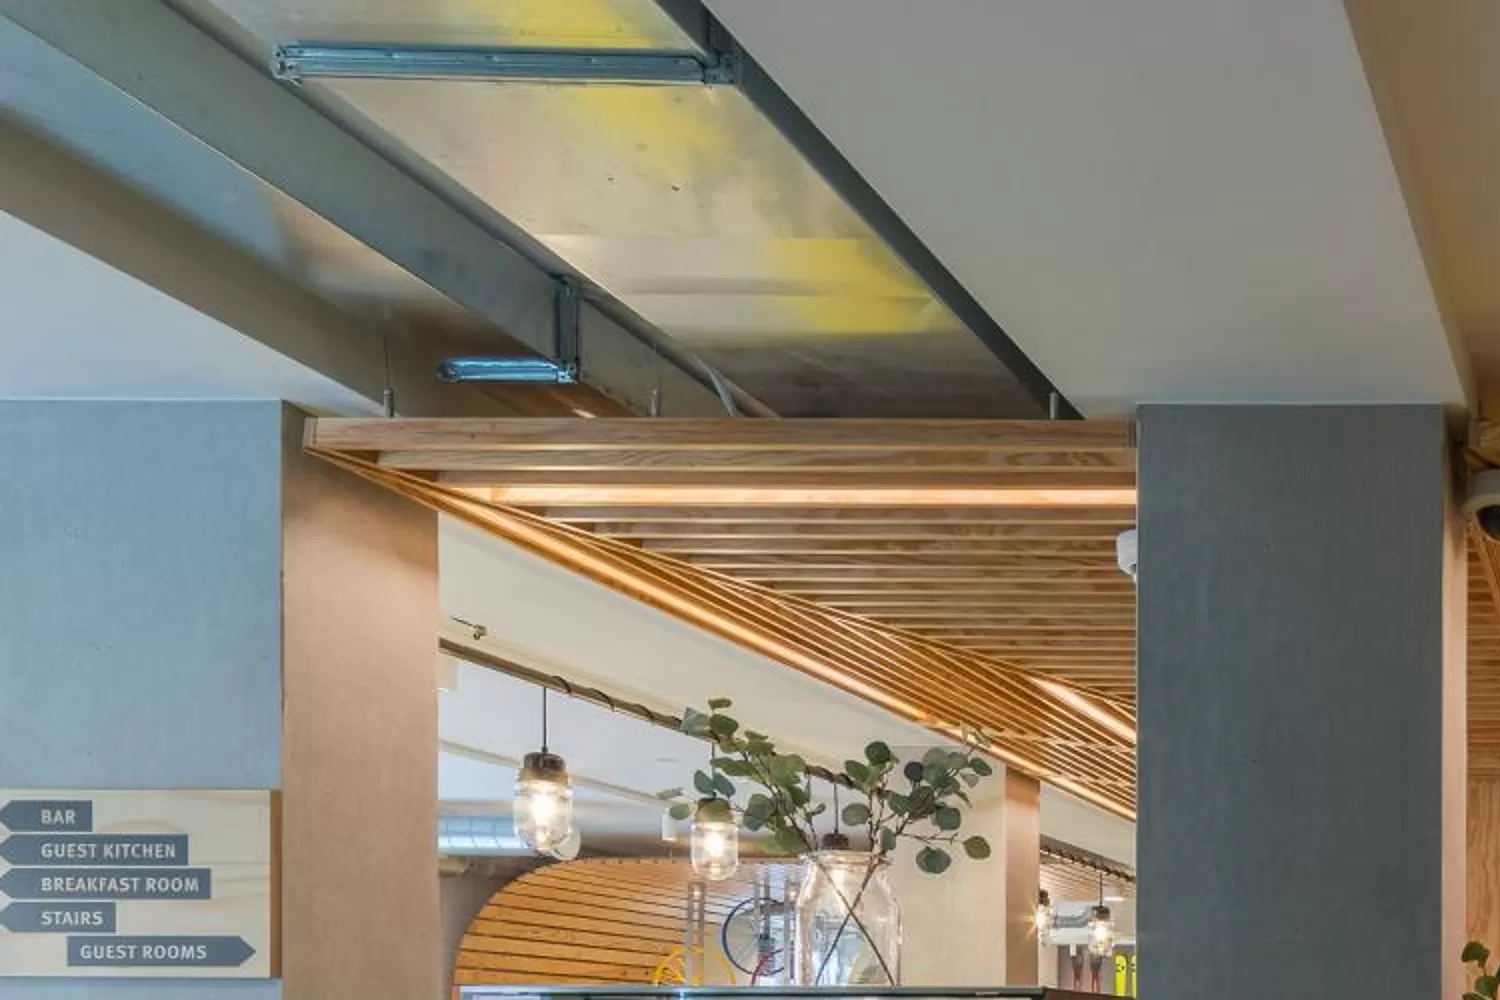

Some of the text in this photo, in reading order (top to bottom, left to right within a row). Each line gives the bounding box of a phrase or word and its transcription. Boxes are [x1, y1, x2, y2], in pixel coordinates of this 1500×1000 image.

[41, 809, 76, 825] BAR
[41, 843, 176, 859] GUEST KITCHEN
[41, 877, 200, 892] BREAKFAST ROOM
[41, 911, 103, 926] STAIRS
[79, 945, 207, 960] GUEST ROOMS
